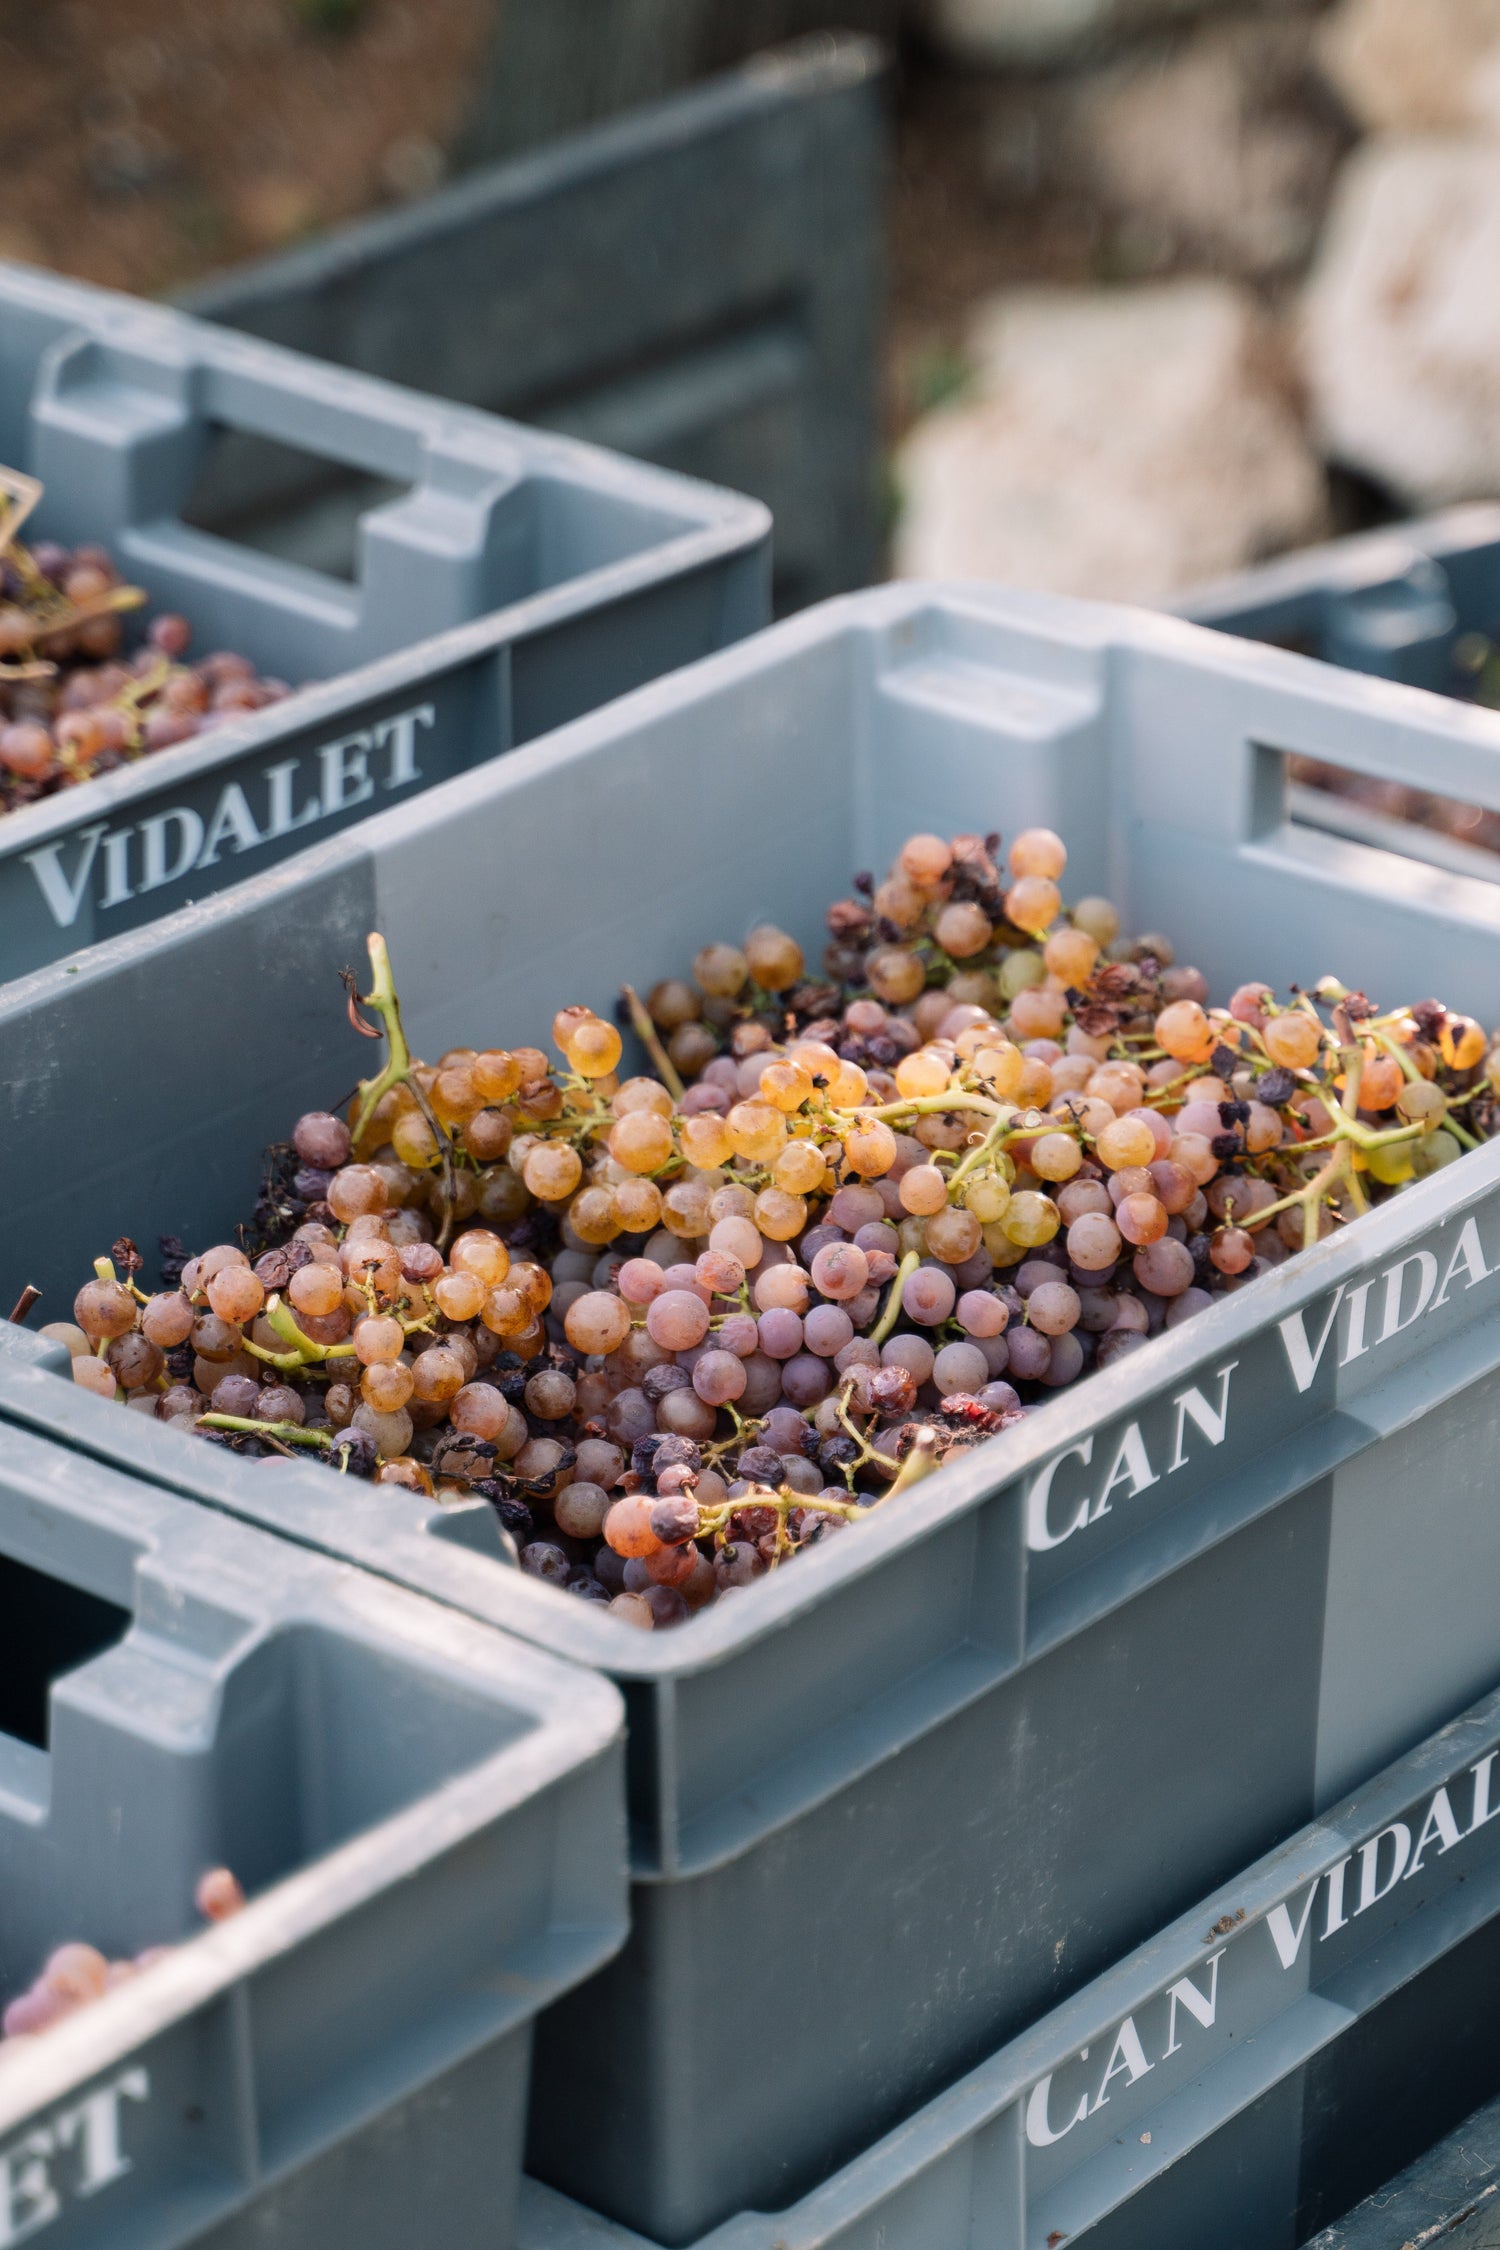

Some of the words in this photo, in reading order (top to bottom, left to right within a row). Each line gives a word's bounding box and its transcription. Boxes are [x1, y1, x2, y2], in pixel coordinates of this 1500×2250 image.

[22, 703, 436, 928] VIDALET
[1026, 1360, 1240, 1553] CAN
[1277, 1215, 1500, 1394] VIDA
[1025, 1947, 1227, 2148] CAN
[1265, 1749, 1500, 1971] VIDAL
